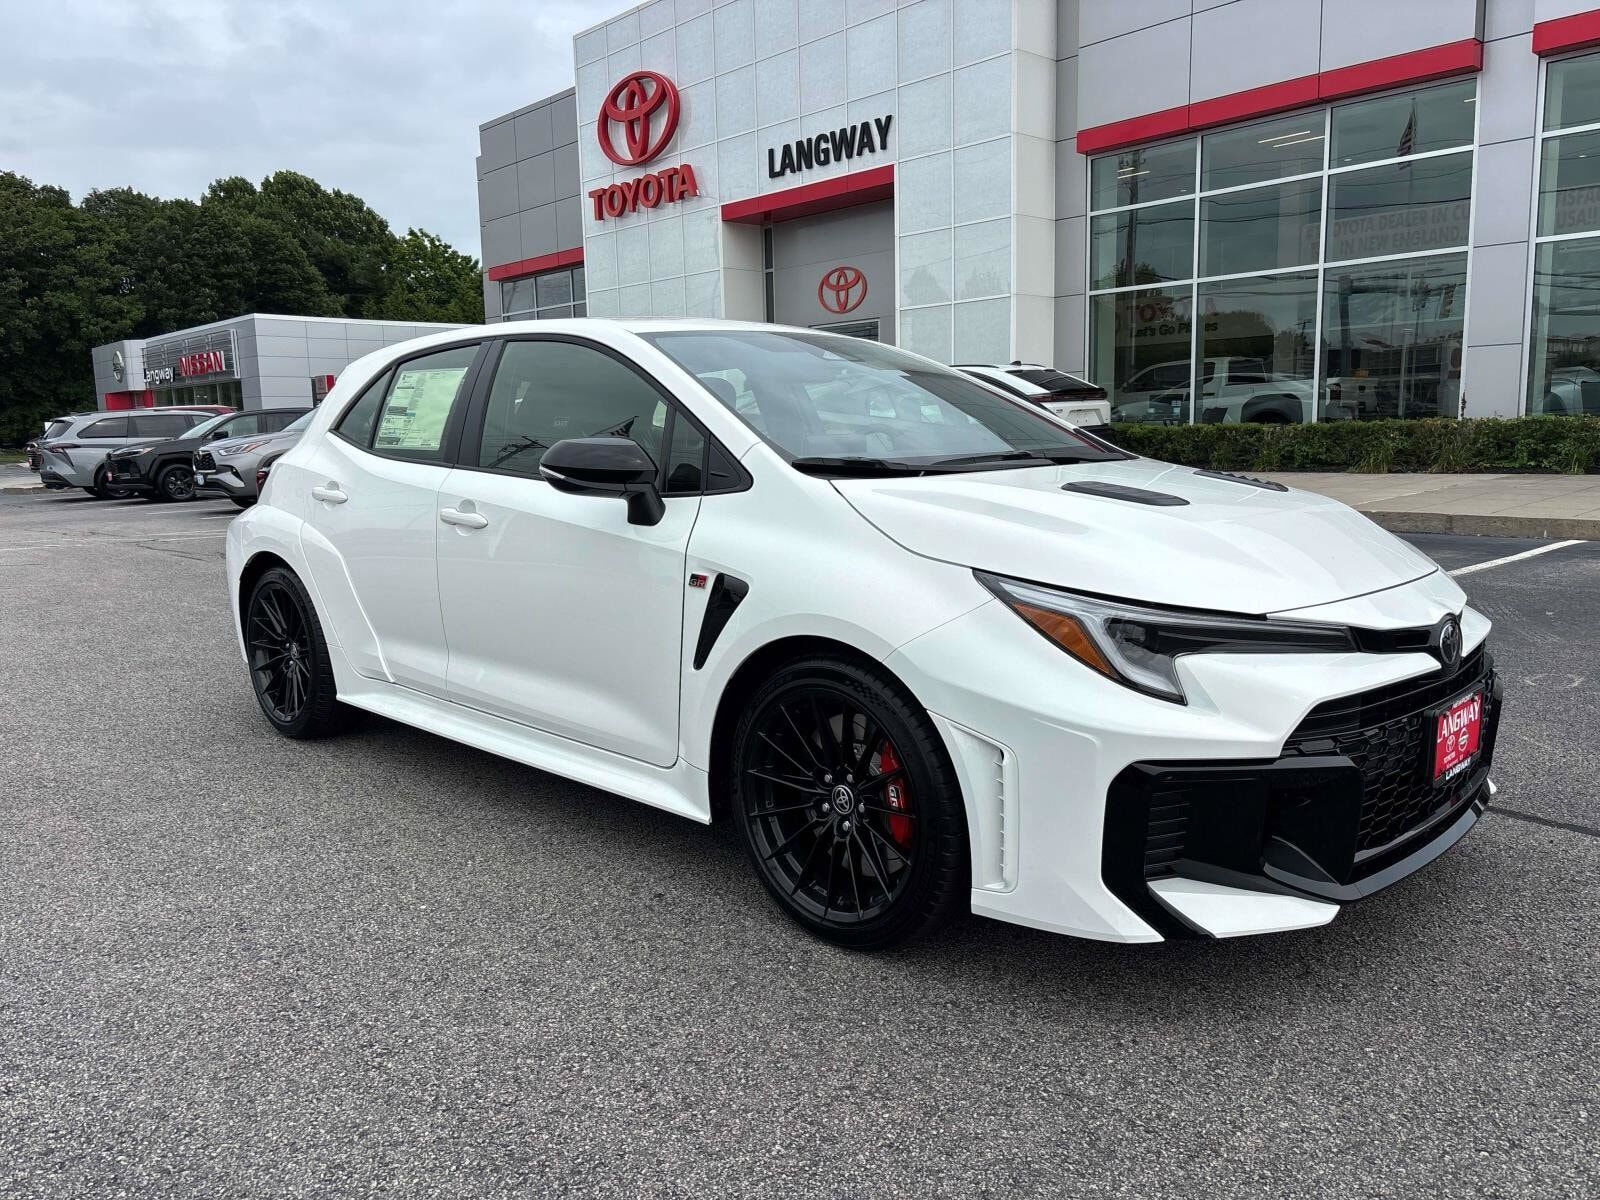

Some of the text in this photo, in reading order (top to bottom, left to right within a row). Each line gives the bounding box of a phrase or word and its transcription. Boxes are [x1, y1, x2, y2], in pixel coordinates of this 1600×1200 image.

[768, 115, 892, 178] LANGWAY
[588, 164, 699, 221] TOYOTA
[1159, 323, 1176, 336] Go
[144, 350, 226, 385] Langway NISSAN
[1437, 699, 1480, 742] LANGWAY
